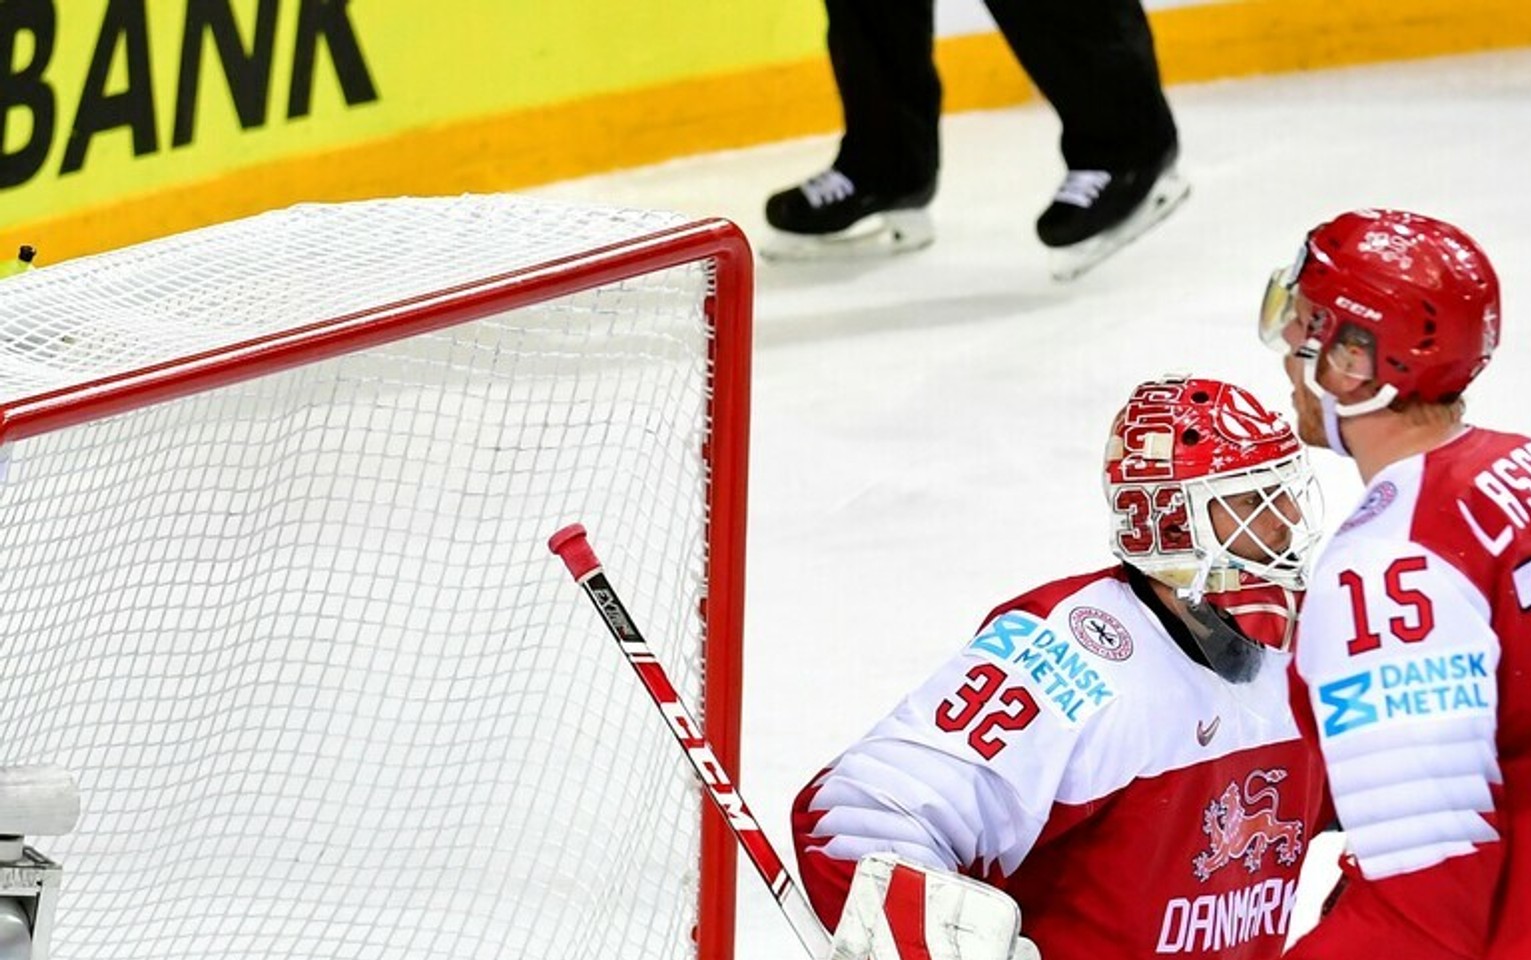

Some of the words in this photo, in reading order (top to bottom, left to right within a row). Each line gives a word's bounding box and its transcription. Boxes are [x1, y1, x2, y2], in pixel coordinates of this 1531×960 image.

[0, 0, 379, 190] BANK
[1114, 486, 1194, 556] 32
[1339, 556, 1434, 656] 15
[1013, 648, 1086, 722] METAL
[1033, 629, 1113, 706] DANSK
[1380, 651, 1488, 689] DANSK
[1386, 682, 1488, 718] METAL
[935, 663, 1040, 761] 32
[661, 701, 759, 832] CCM
